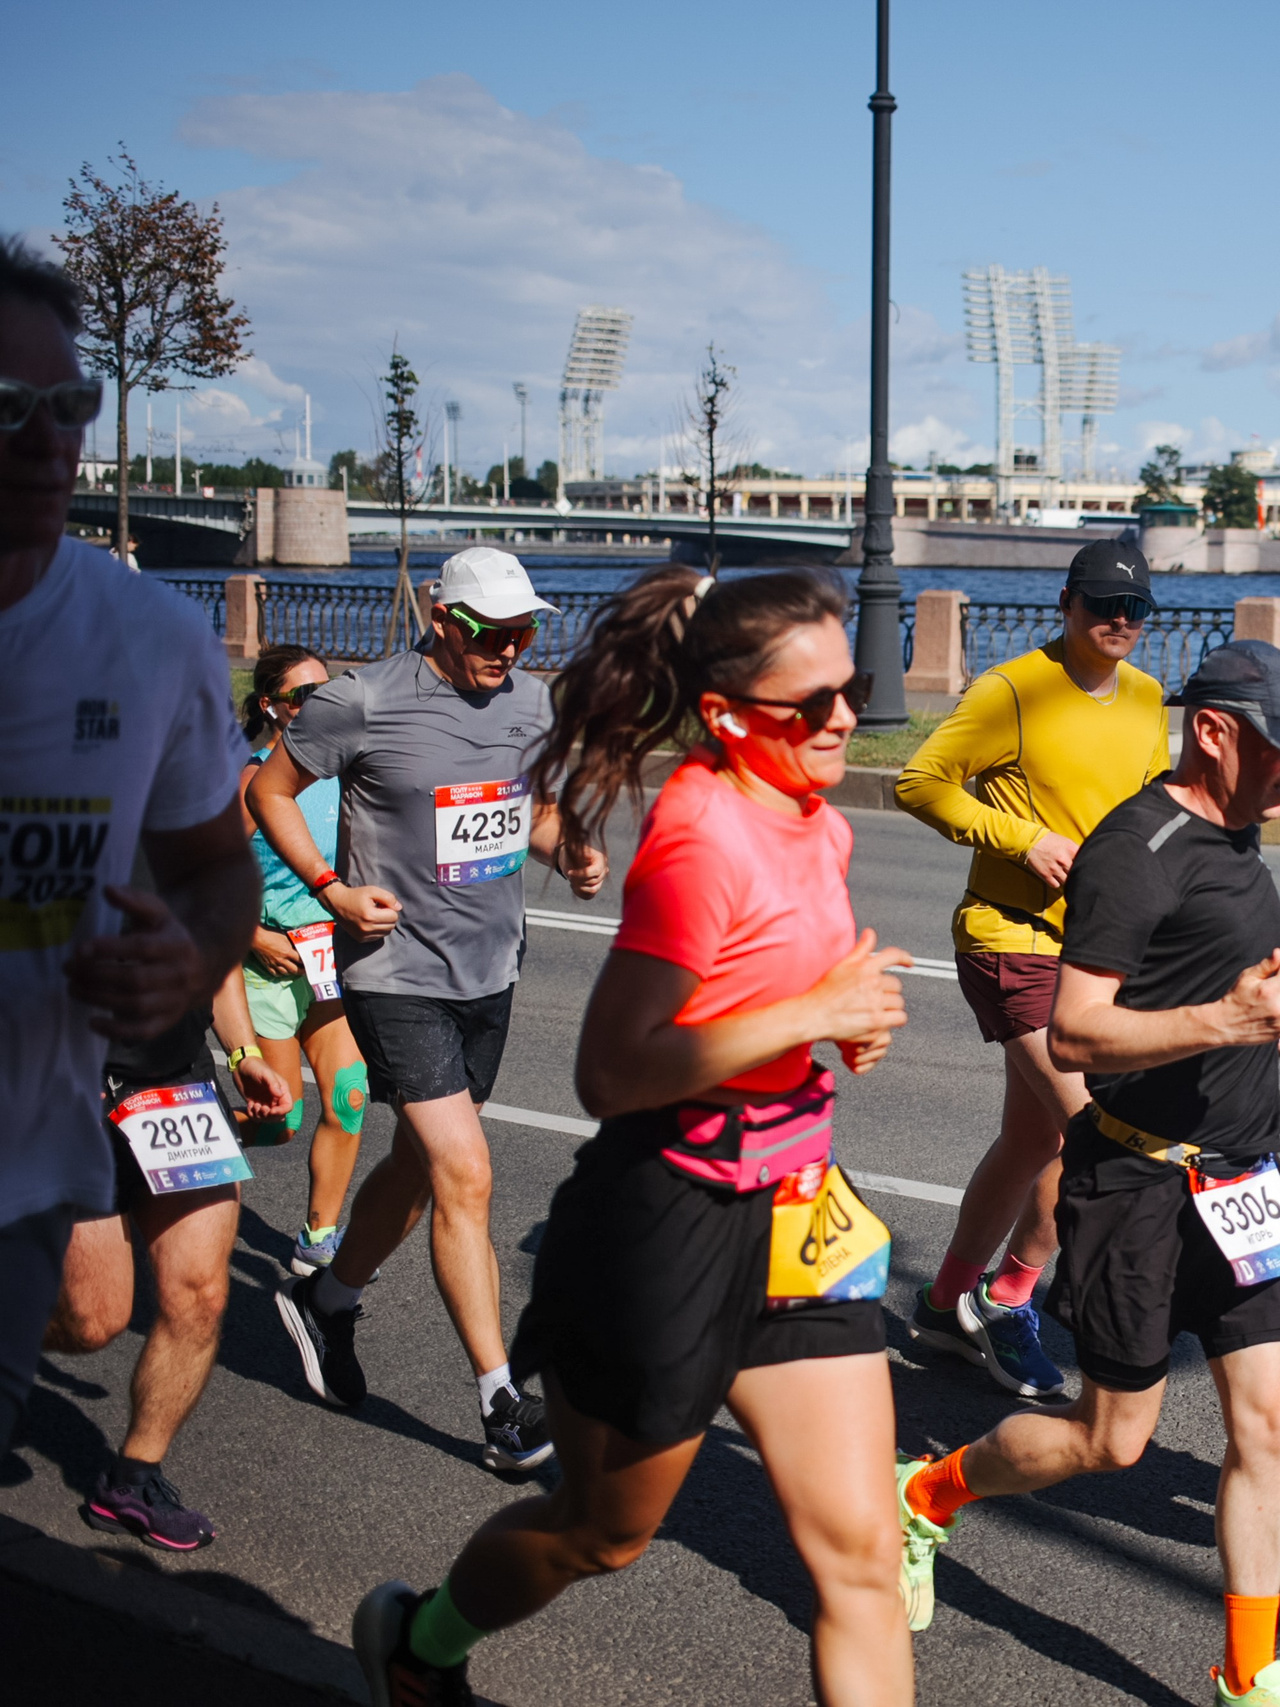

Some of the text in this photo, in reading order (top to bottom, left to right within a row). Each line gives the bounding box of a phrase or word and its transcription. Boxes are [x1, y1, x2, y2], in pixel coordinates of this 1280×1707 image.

[75, 718, 120, 740] STAR
[451, 806, 521, 843] 4235
[475, 841, 503, 854] МАРАТ
[449, 865, 461, 882] E
[10, 874, 95, 904] 2022
[323, 984, 334, 996] E
[141, 1113, 221, 1150] 2812
[167, 1145, 213, 1162] ДМИТРИЙ
[158, 1170, 174, 1188] E
[1246, 1229, 1274, 1246] ИГОРЬ
[1238, 1259, 1255, 1281] D
